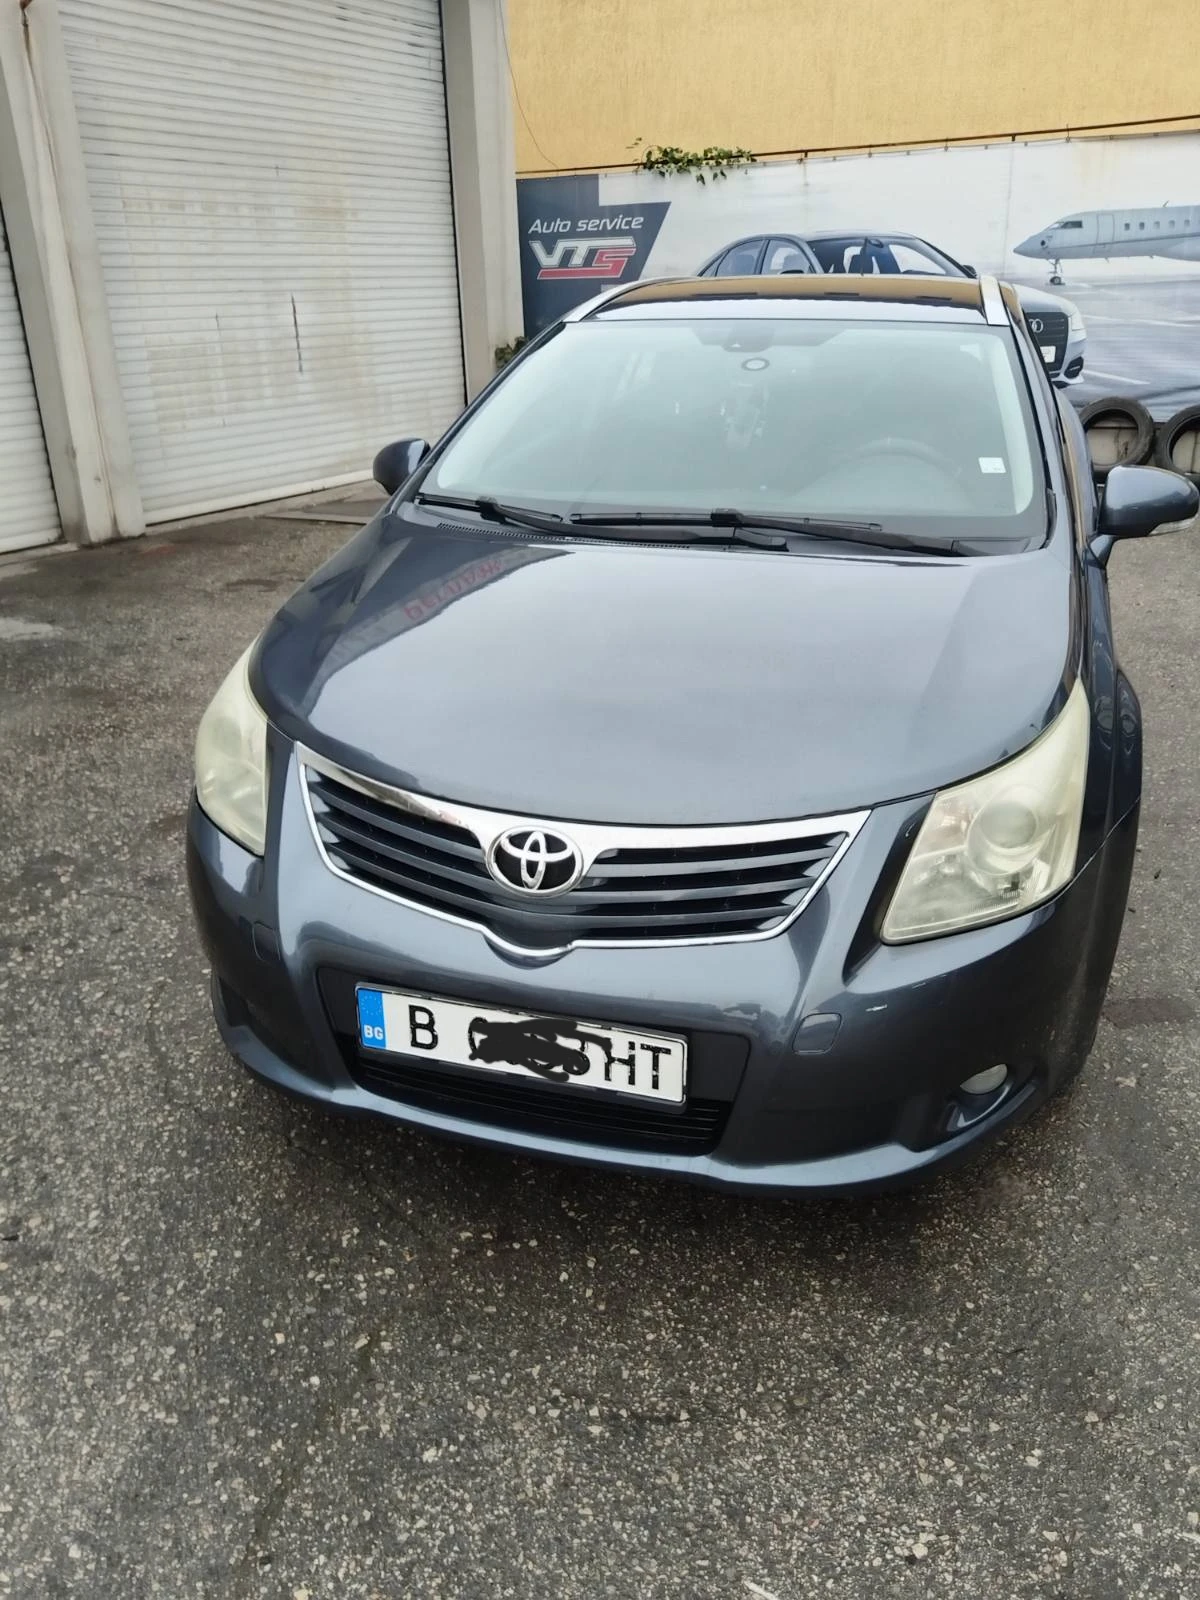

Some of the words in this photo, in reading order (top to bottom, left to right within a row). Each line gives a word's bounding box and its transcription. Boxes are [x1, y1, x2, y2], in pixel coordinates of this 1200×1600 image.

[528, 217, 571, 234] Auto
[576, 214, 644, 231] service
[528, 236, 636, 280] VTS
[363, 1023, 384, 1040] BG
[408, 1004, 439, 1050] B
